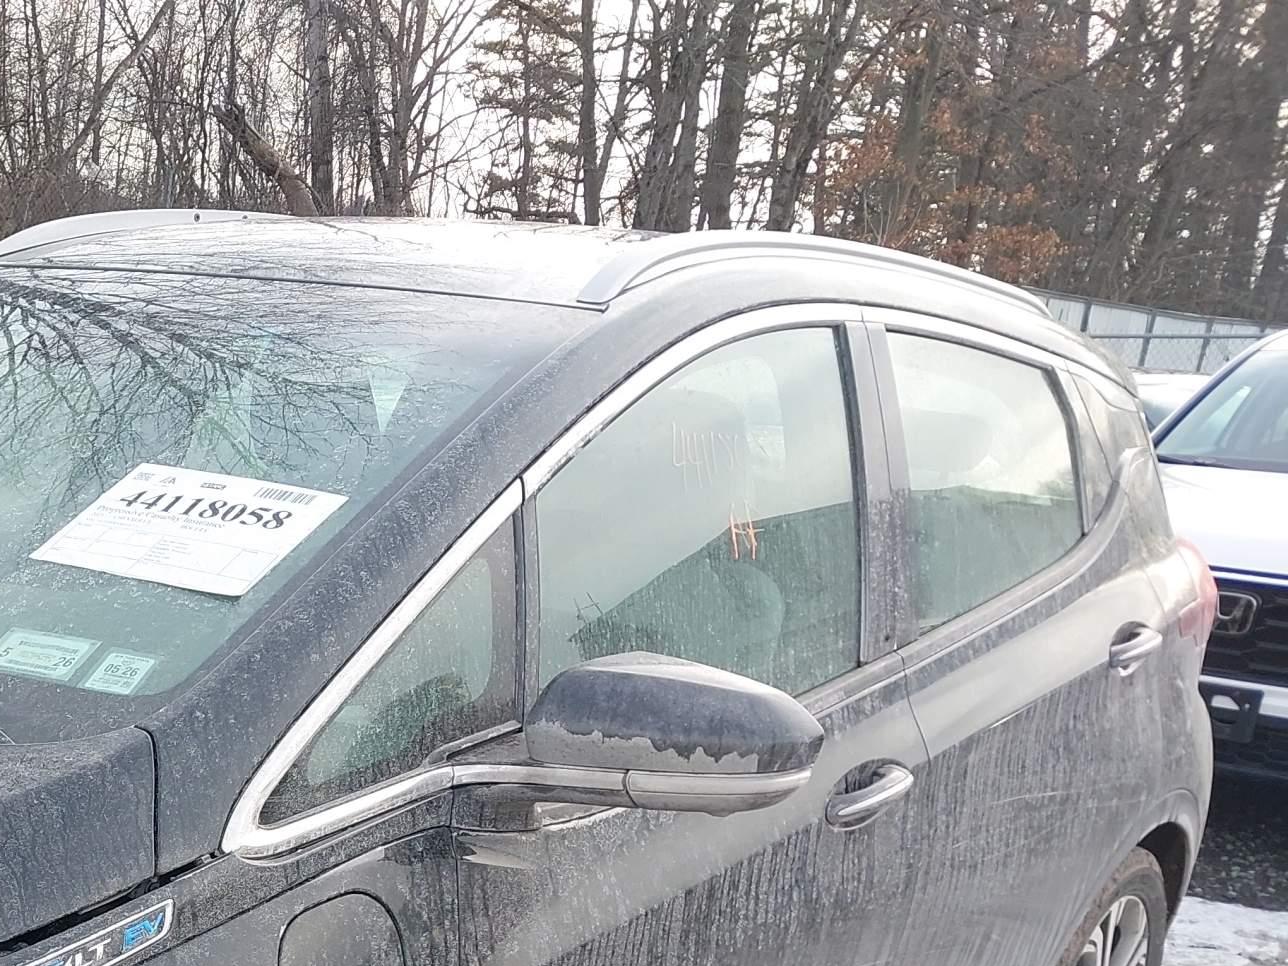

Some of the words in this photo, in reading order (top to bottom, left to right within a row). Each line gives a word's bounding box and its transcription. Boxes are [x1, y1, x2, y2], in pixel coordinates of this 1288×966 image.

[120, 490, 293, 530] 44118058
[53, 656, 76, 668] 26
[103, 663, 121, 674] 05
[121, 666, 140, 677] 26
[121, 912, 164, 954] EV
